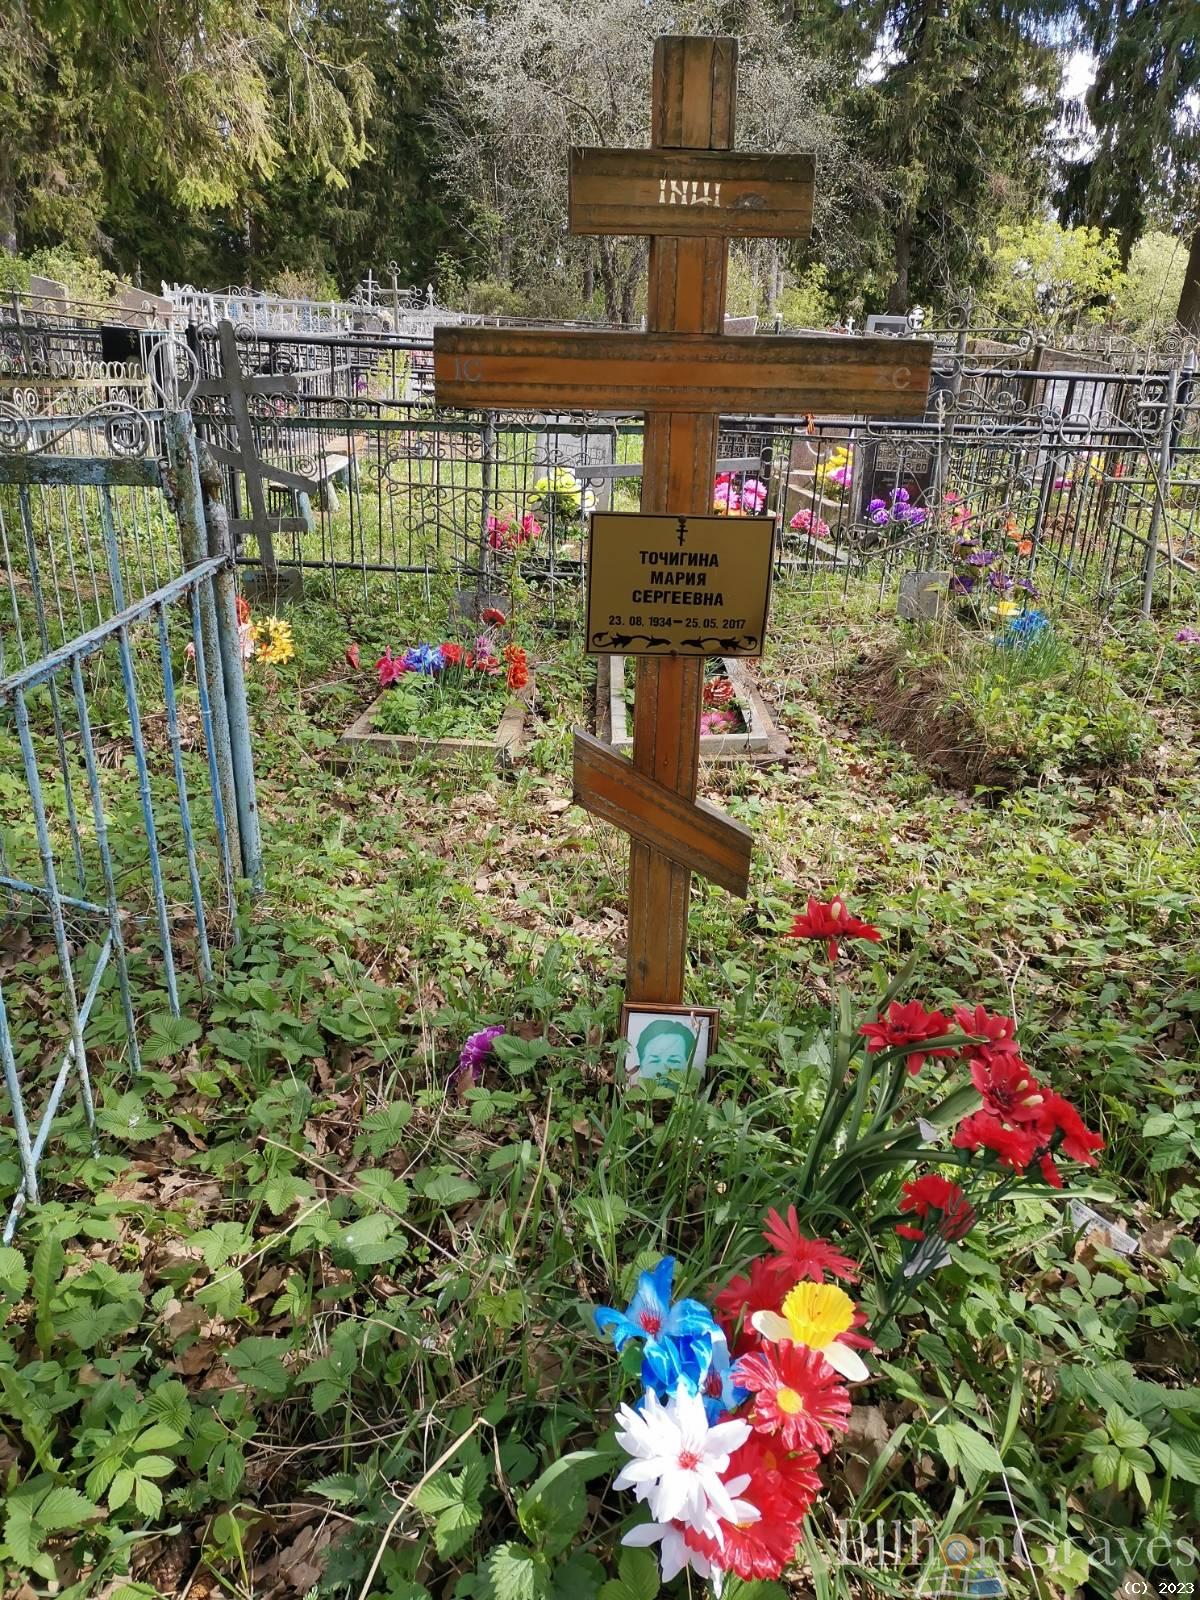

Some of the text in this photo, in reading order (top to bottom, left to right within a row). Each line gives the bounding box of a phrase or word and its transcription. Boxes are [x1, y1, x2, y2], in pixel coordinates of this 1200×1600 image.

[639, 550, 719, 568] ТОЧИГИНА
[650, 570, 707, 587] МАРИЯ
[631, 589, 724, 607] СЕРГЕЕВНА
[721, 618, 747, 630] 2017
